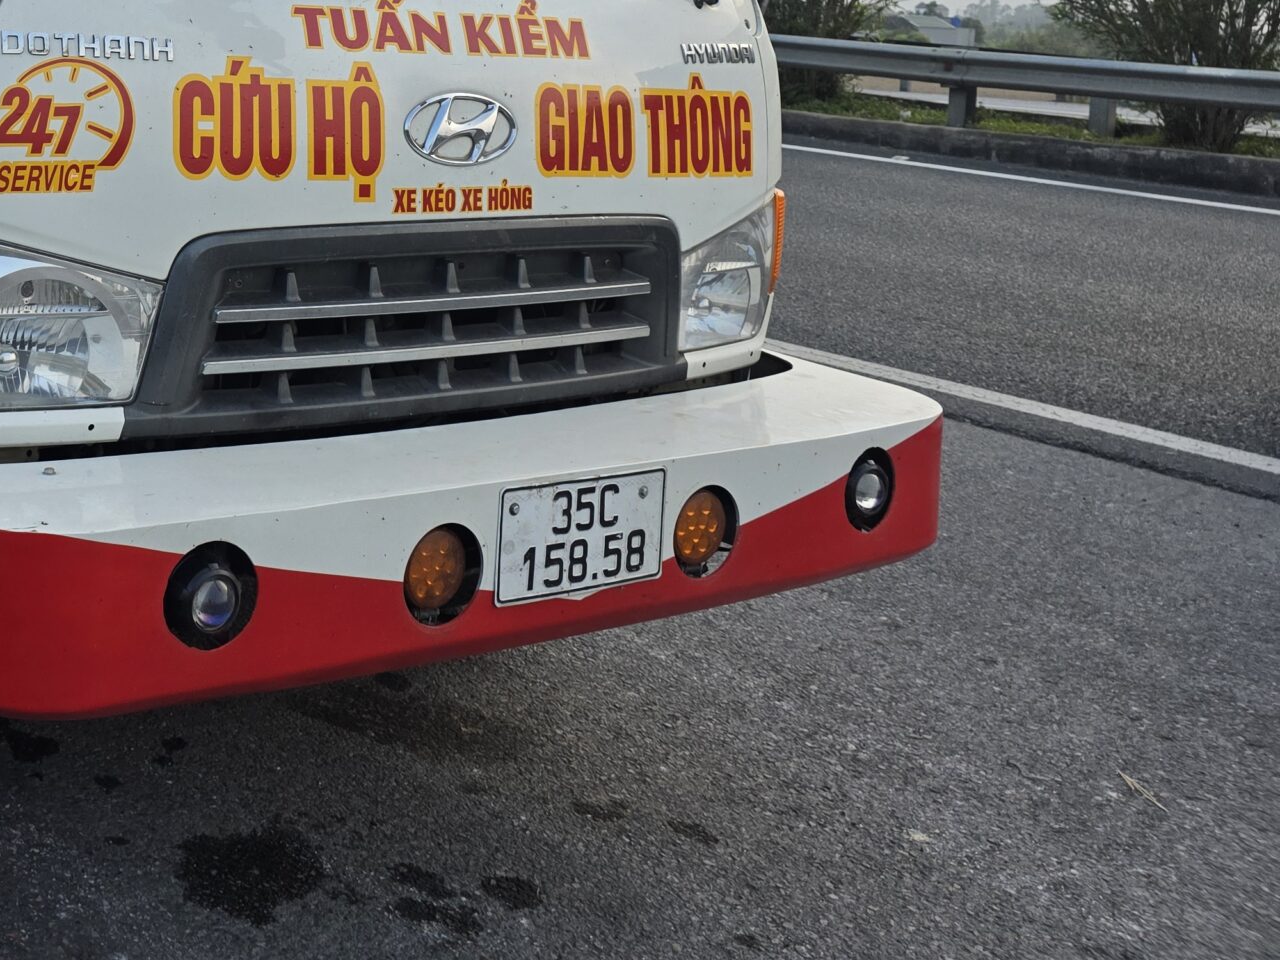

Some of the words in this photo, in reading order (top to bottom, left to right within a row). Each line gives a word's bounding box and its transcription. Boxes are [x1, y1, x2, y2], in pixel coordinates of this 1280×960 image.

[0, 28, 175, 61] DOTHANH
[680, 43, 756, 65] HYUNDAI
[173, 56, 297, 180] CỨU
[306, 62, 385, 203] HỘ
[535, 81, 636, 178] GIAO
[639, 72, 753, 178] THÔNG
[392, 188, 418, 214] XE
[421, 183, 457, 213] KÉO
[460, 185, 484, 212] XE
[487, 178, 533, 211] HỎNG
[551, 483, 620, 536] 35C
[522, 528, 647, 592] 158.58
